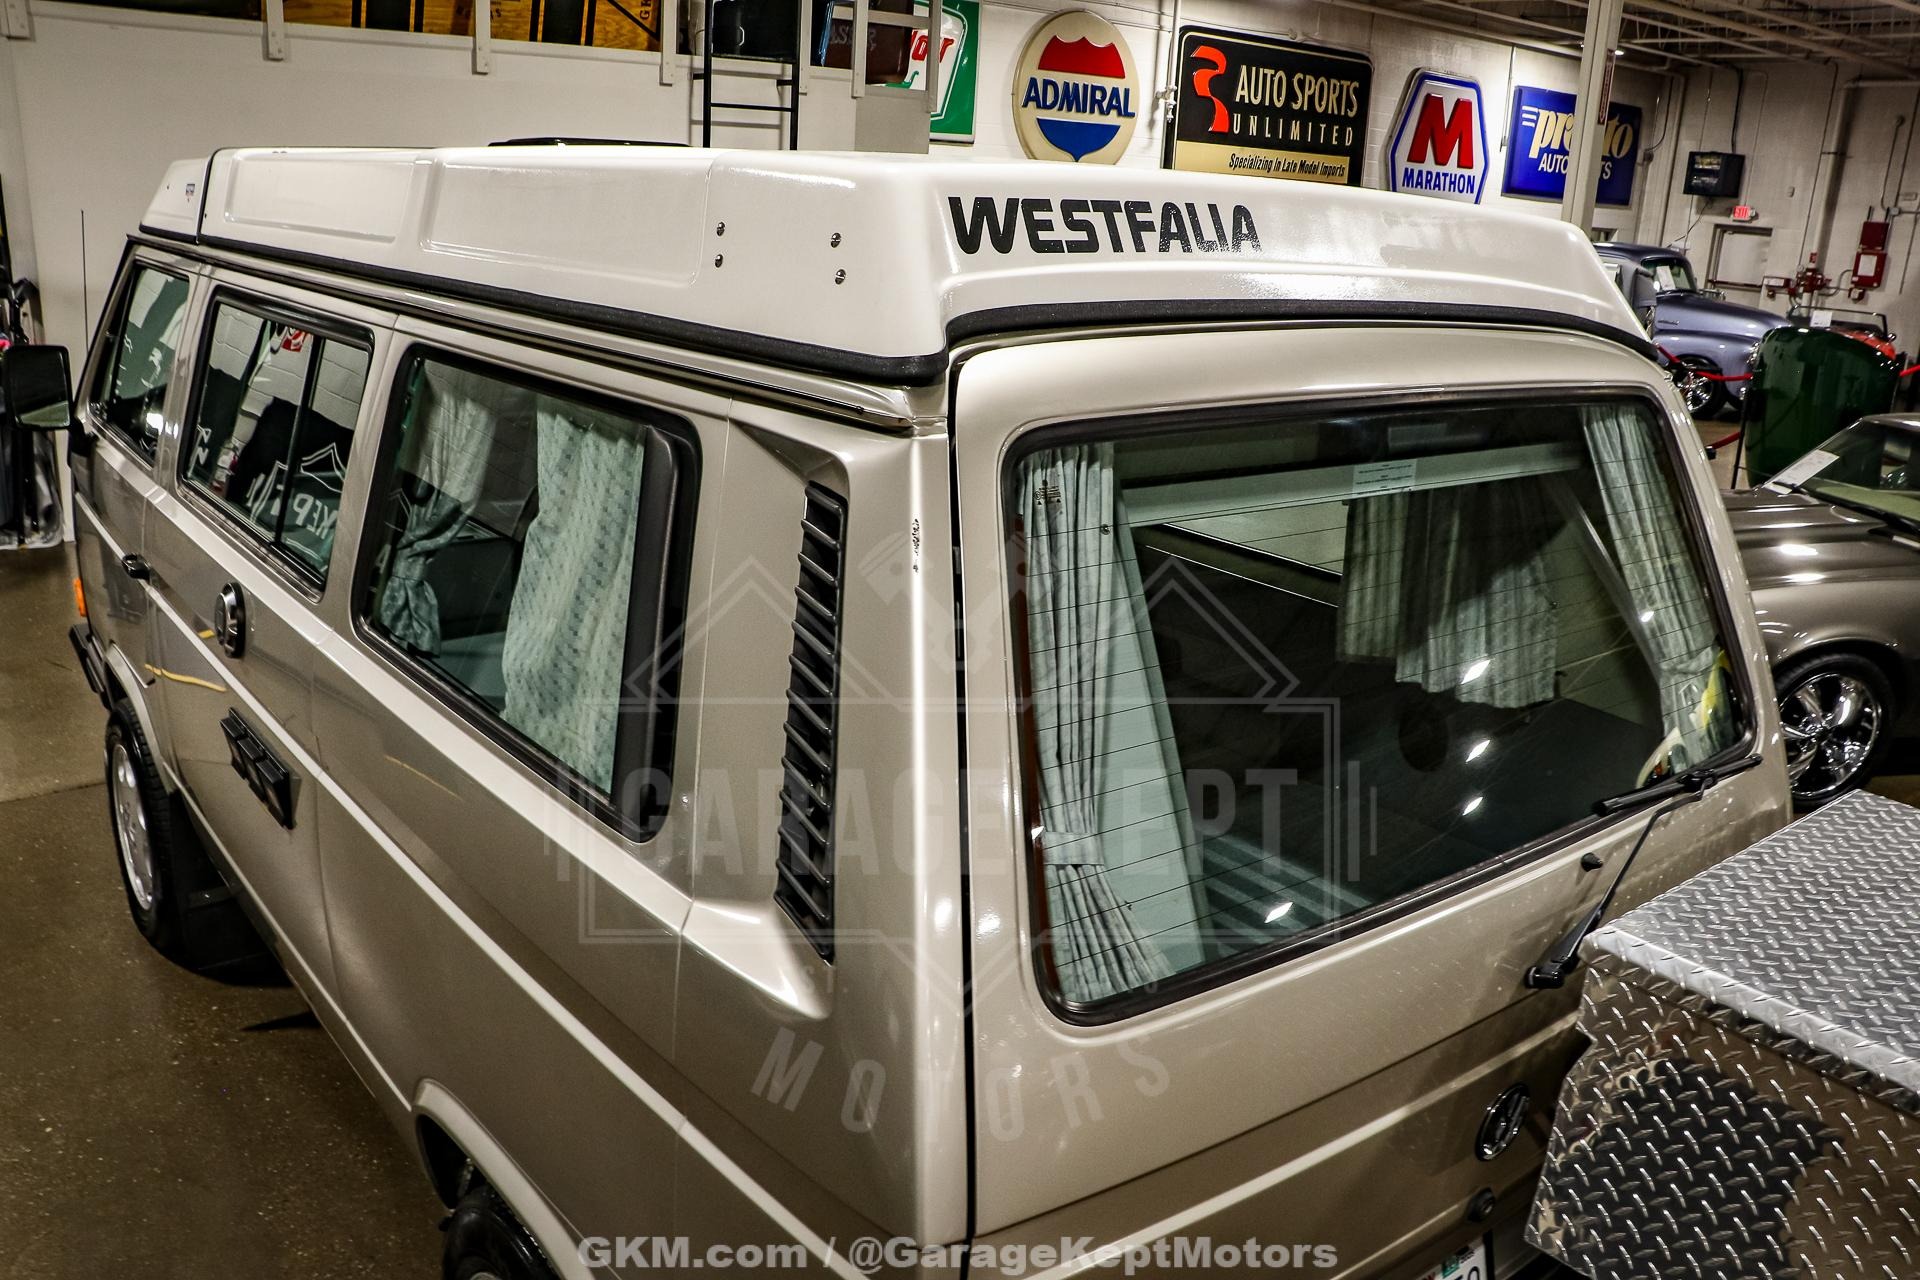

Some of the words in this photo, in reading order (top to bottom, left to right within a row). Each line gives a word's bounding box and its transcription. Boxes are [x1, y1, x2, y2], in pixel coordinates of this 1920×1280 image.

[1022, 77, 1136, 119] ADMIRAL
[1235, 64, 1287, 109] AUTO
[1291, 72, 1360, 119] SPORTS
[1232, 113, 1354, 147] UNLIMITED
[1406, 92, 1474, 170] M
[1528, 108, 1635, 159] prto
[1228, 152, 1273, 173] Specializing
[1273, 156, 1282, 171] In
[1281, 157, 1298, 174] Late
[1297, 159, 1320, 176] Model
[1319, 161, 1346, 179] Imports
[1402, 166, 1477, 195] MARATHON
[1538, 152, 1569, 174] AUTO
[947, 195, 1264, 255] WESTFALIA
